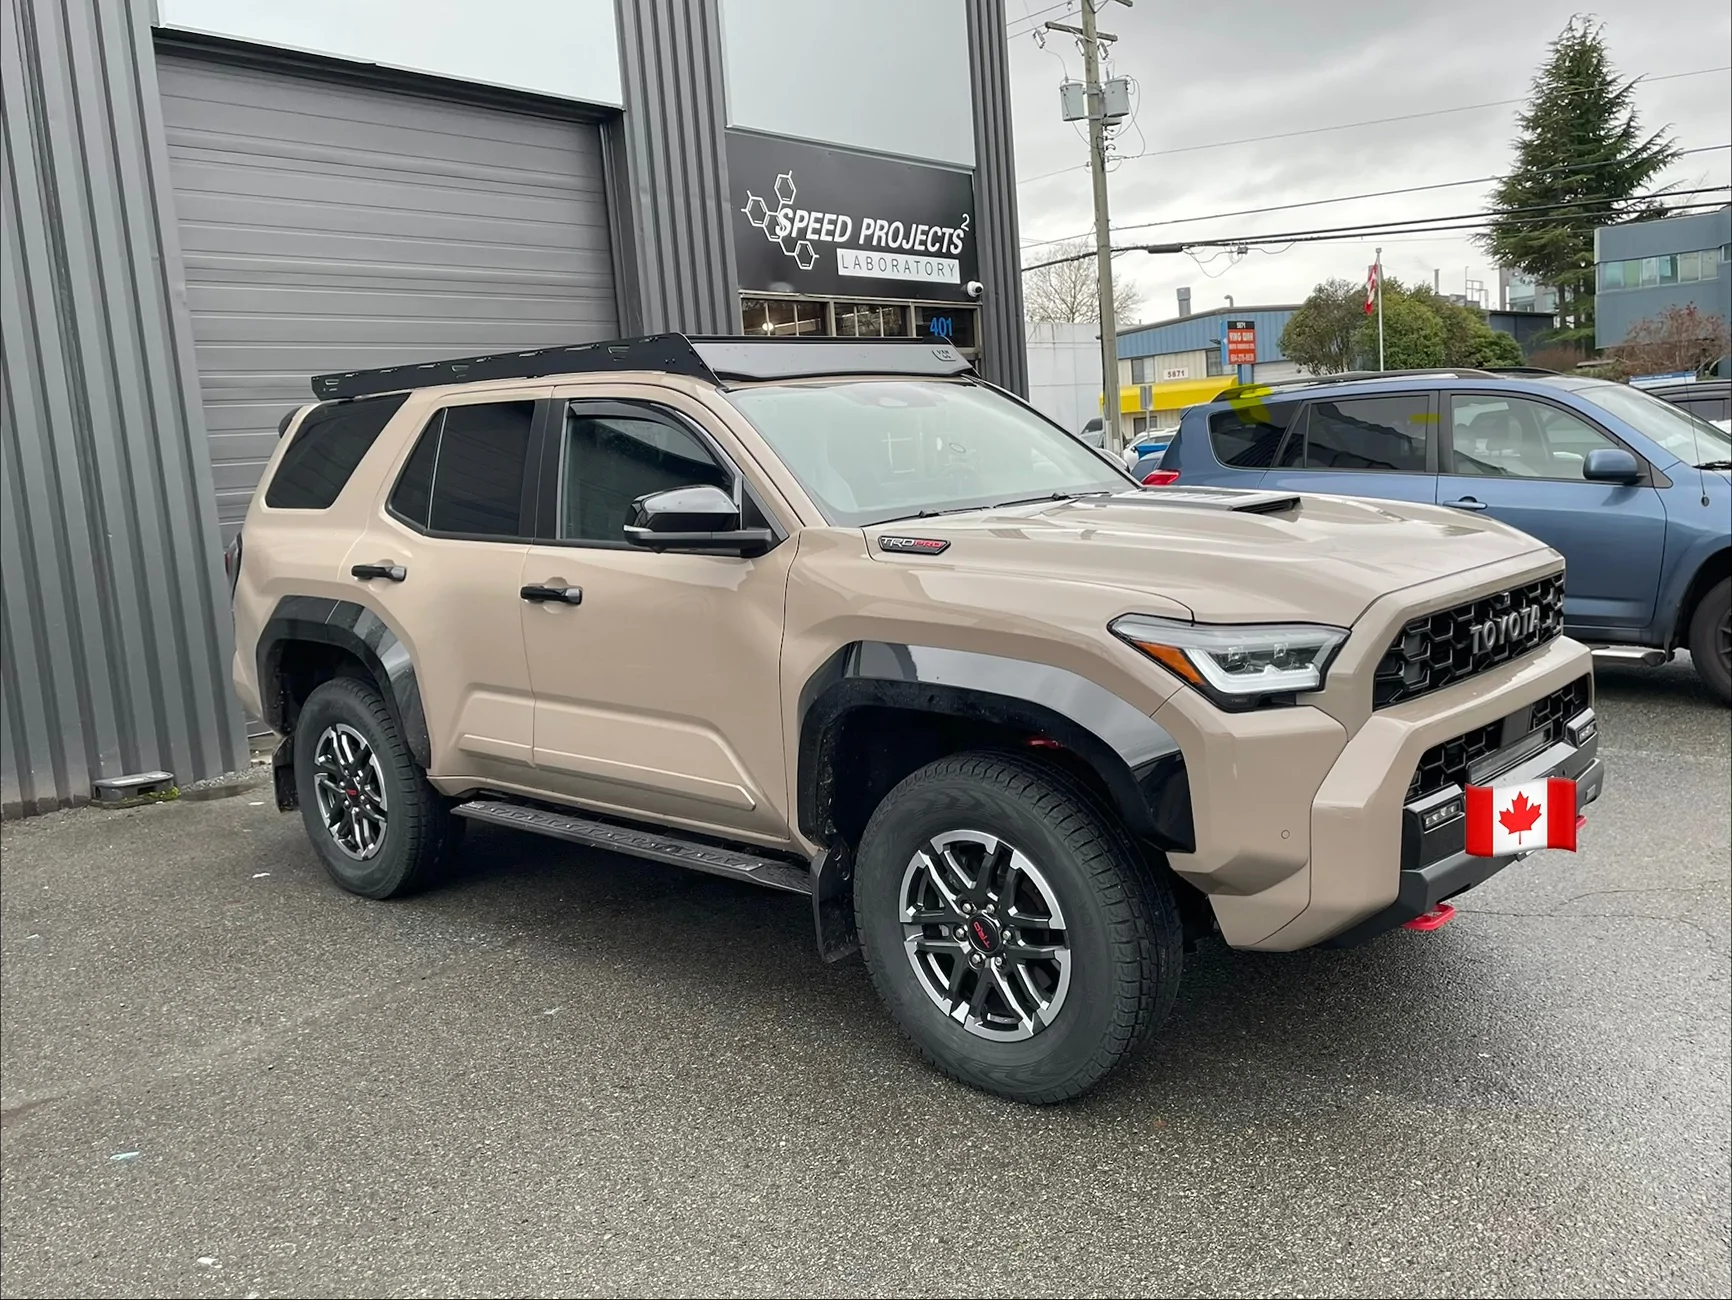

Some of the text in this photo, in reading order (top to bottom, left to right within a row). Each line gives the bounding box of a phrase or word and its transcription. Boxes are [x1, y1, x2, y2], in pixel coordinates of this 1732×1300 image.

[775, 208, 853, 242] SPEED
[858, 218, 965, 254] PROJECTS
[841, 254, 956, 277] LABORATORY
[929, 317, 953, 337] 401
[1167, 369, 1185, 378] 5871
[1468, 604, 1541, 654] TOYOTA
[973, 921, 990, 949] TRD
